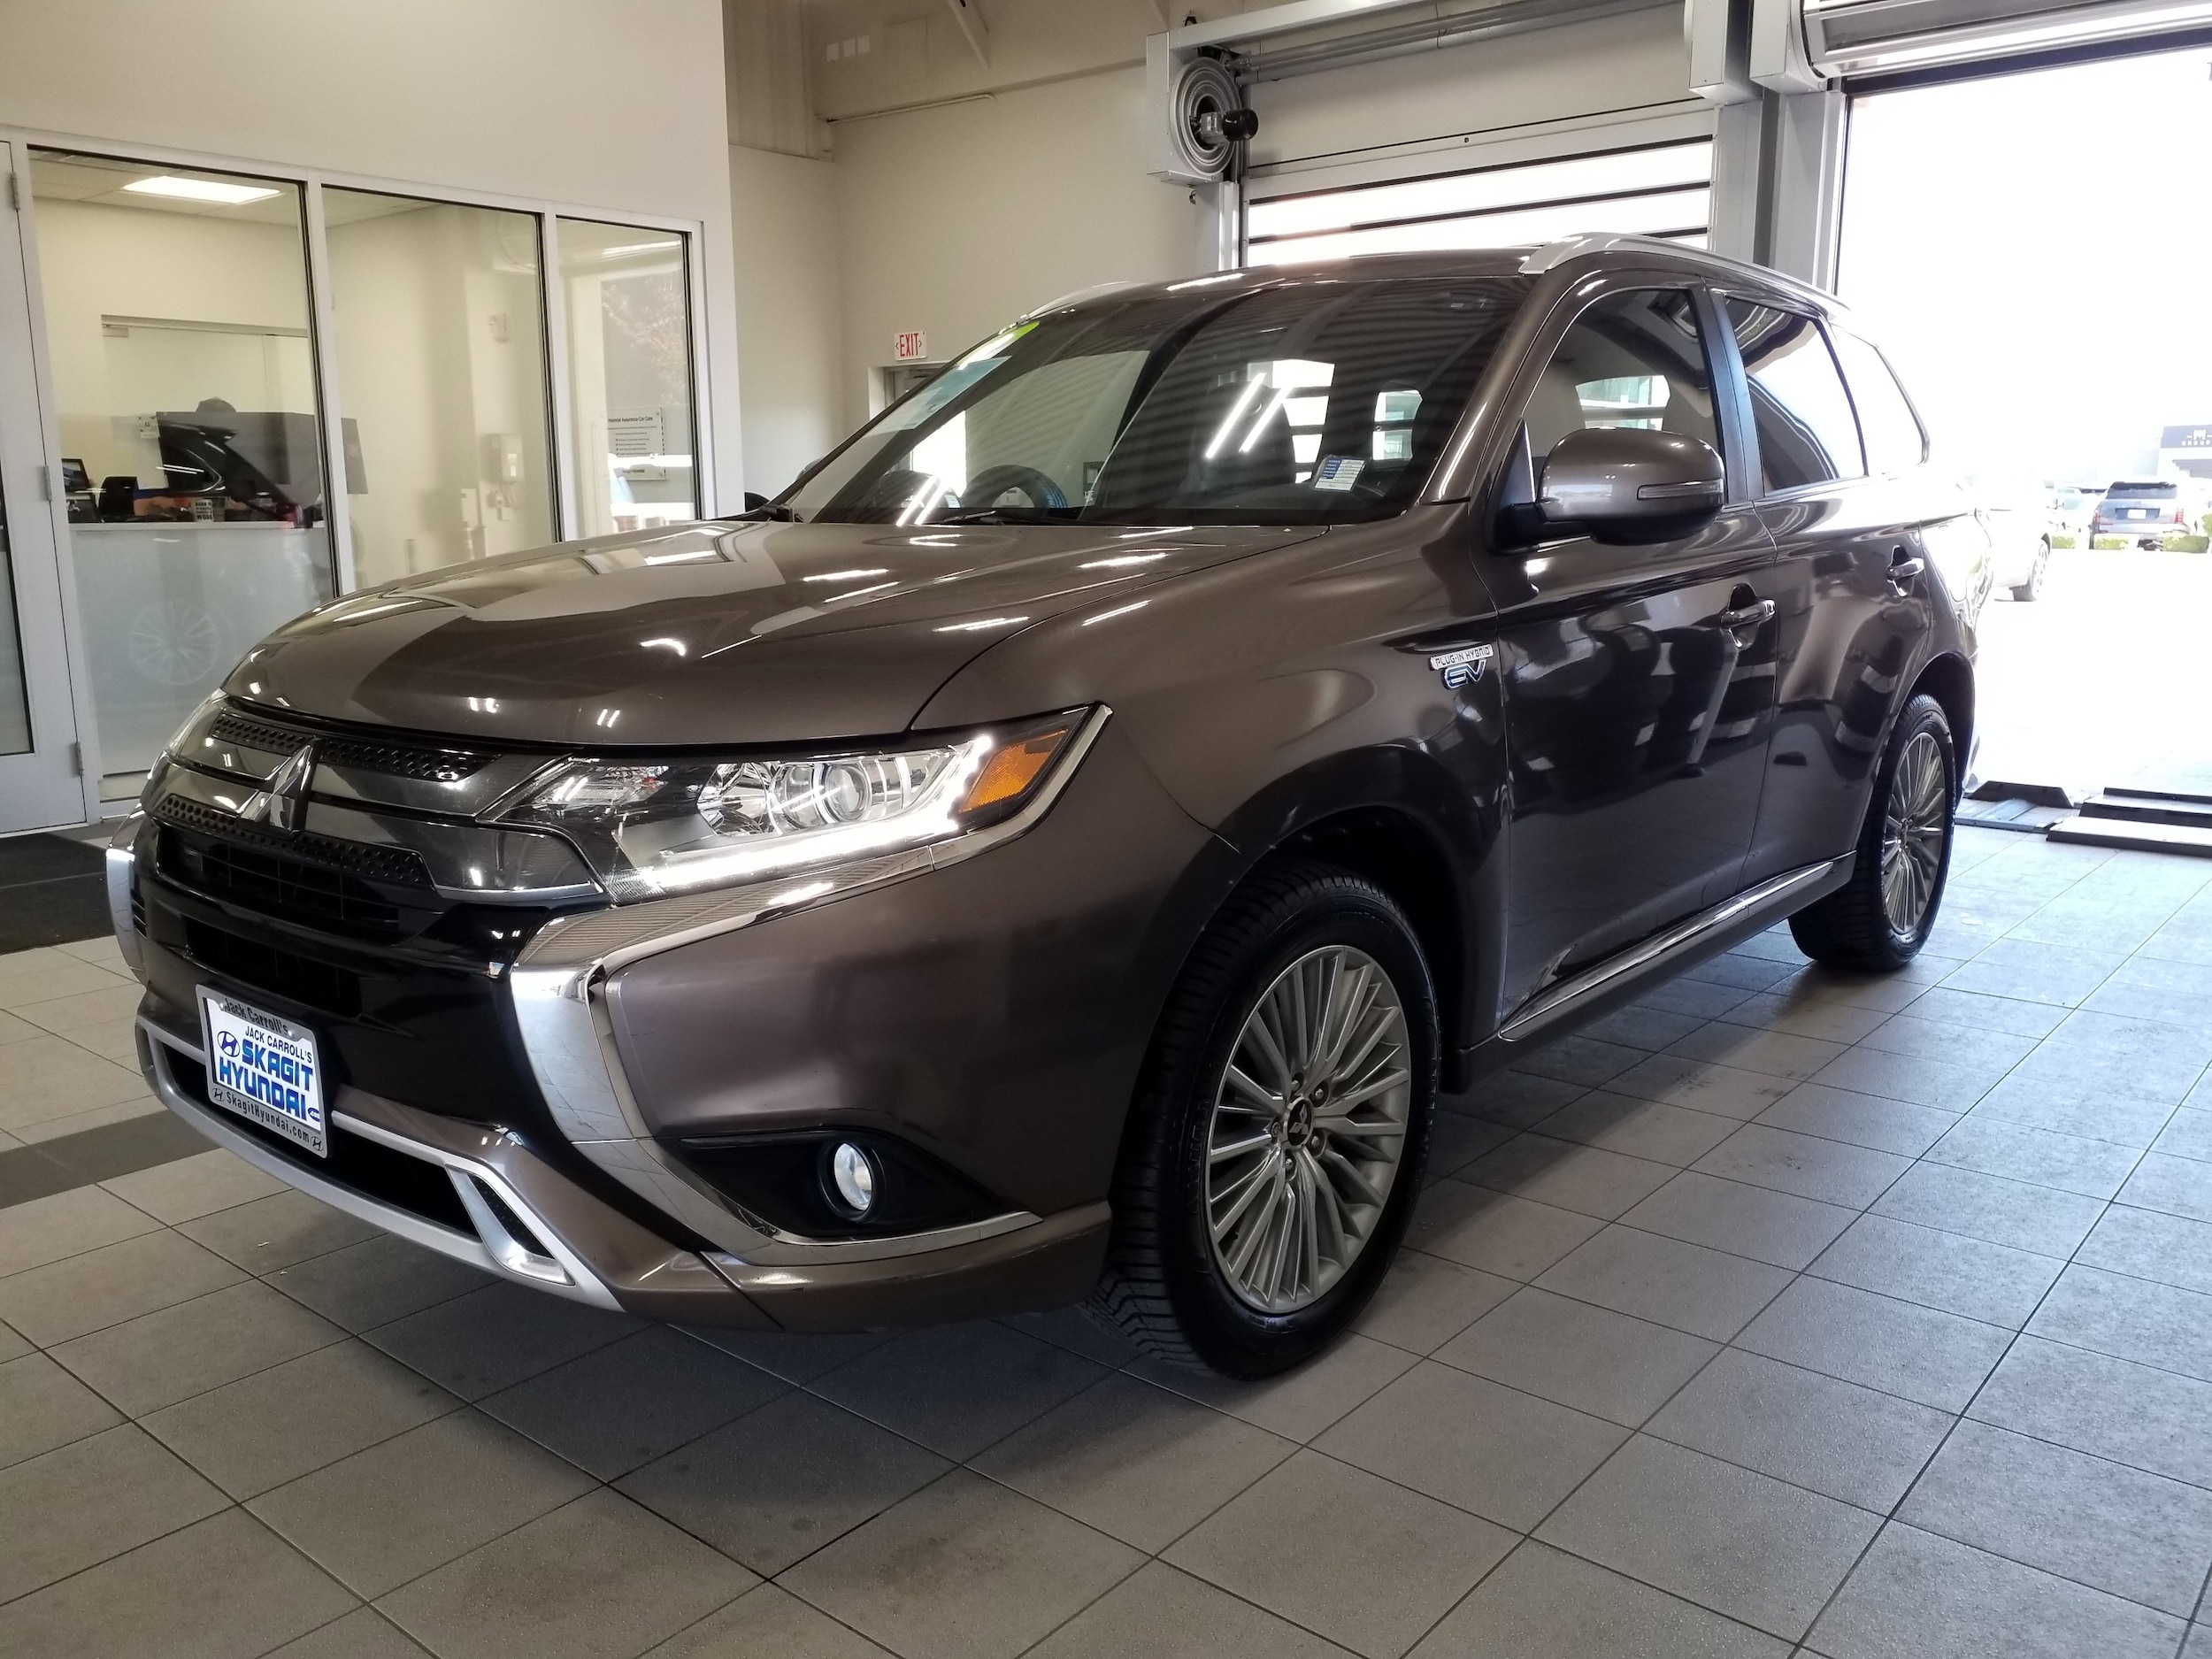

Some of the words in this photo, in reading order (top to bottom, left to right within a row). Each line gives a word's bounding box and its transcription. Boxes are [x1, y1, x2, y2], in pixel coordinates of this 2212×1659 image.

[899, 333, 919, 357] EXIT
[1435, 653, 1464, 667] PLUG-IN
[1466, 647, 1491, 660] HYBRID
[1445, 658, 1487, 689] EV
[224, 998, 245, 1019] Jack
[247, 1007, 288, 1034] Carroll's
[245, 1025, 265, 1044] JACK
[266, 1037, 312, 1064] CARROLL'S
[242, 1039, 313, 1093] SKAGIT
[219, 1056, 307, 1122] HYUNDAI
[226, 1091, 311, 1144] SkagitHyundai.com
